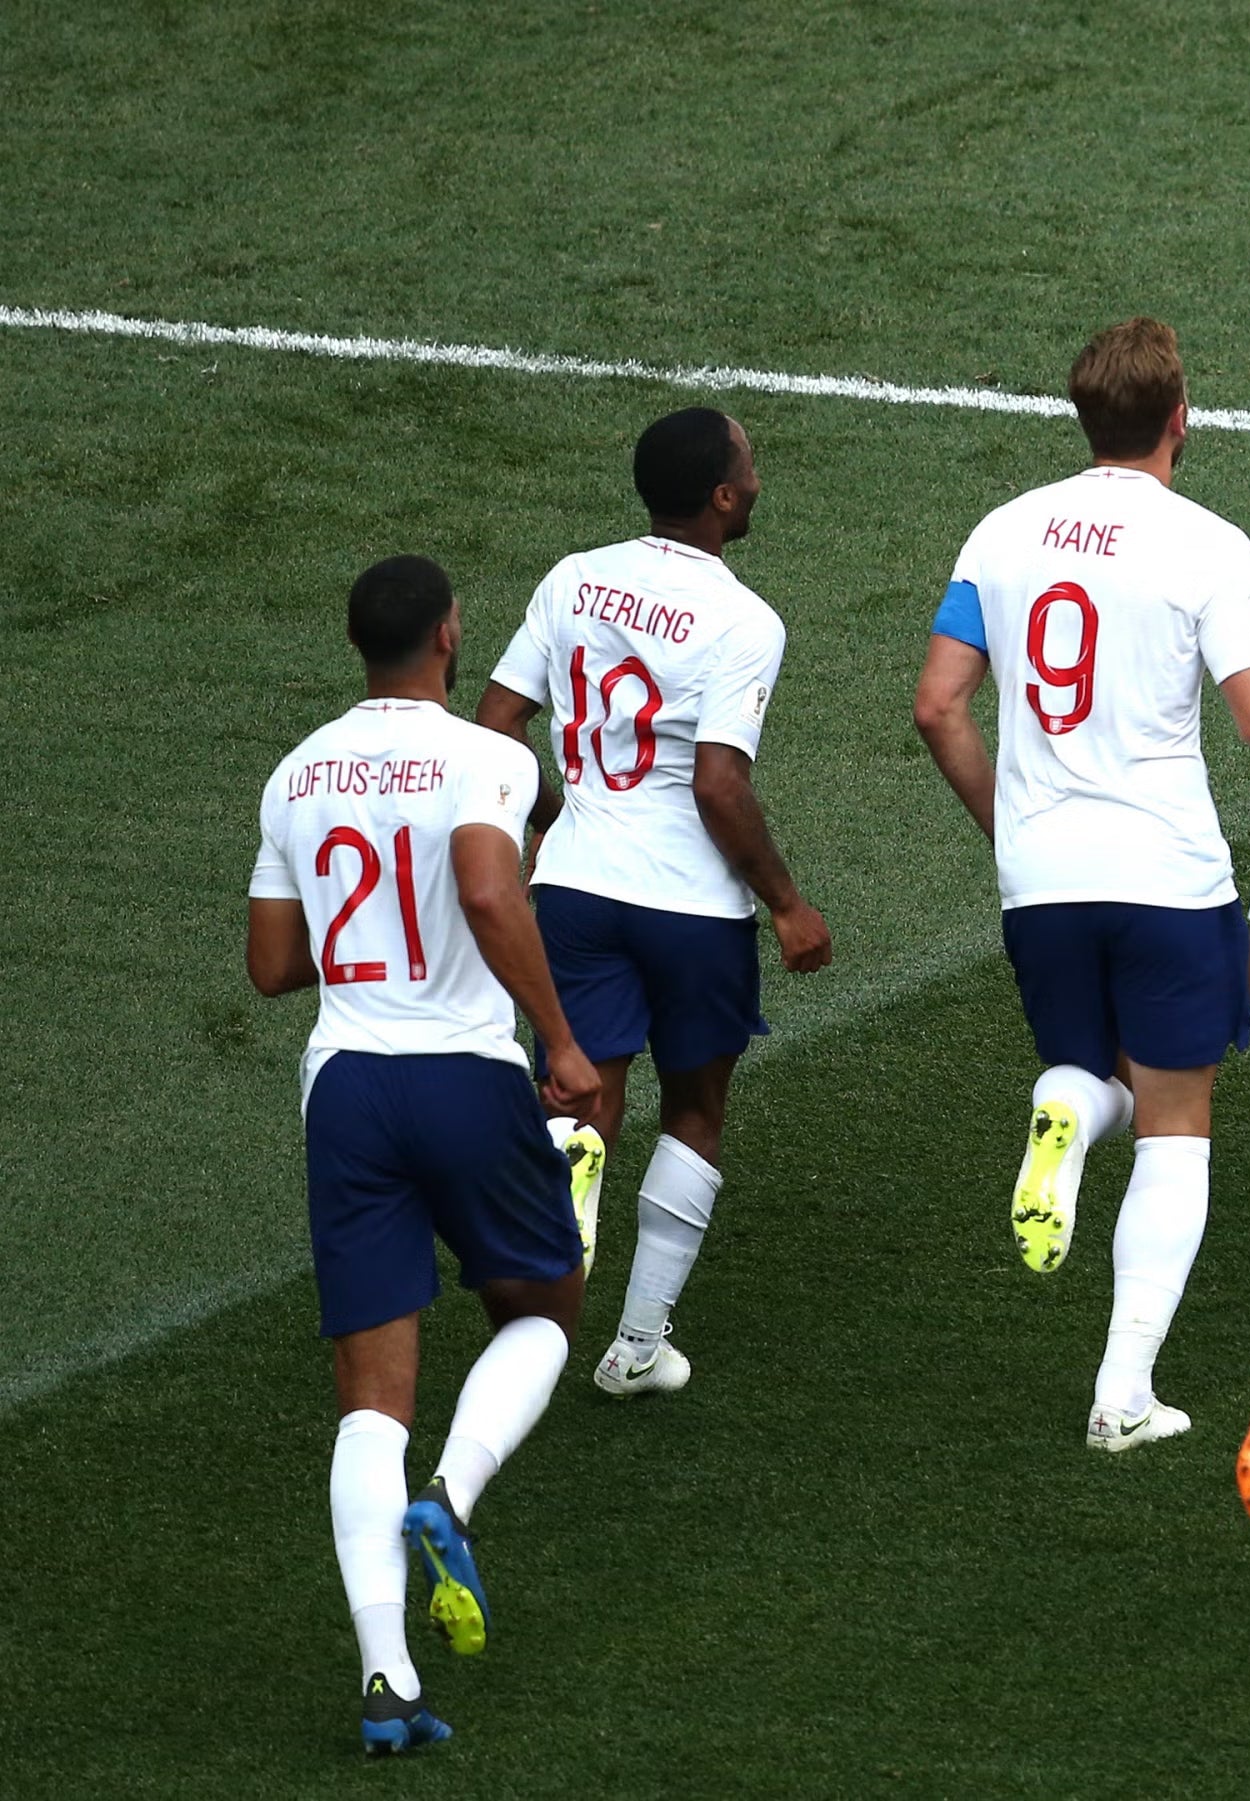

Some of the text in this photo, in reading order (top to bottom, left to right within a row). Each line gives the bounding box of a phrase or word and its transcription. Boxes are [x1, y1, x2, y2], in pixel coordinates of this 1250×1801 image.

[1041, 516, 1125, 557] KANE
[573, 582, 696, 644] STERLING
[1025, 580, 1099, 736] 9
[563, 645, 664, 792] 10
[288, 759, 447, 802] LOFTUS-CHEEK
[315, 825, 427, 986] 21
